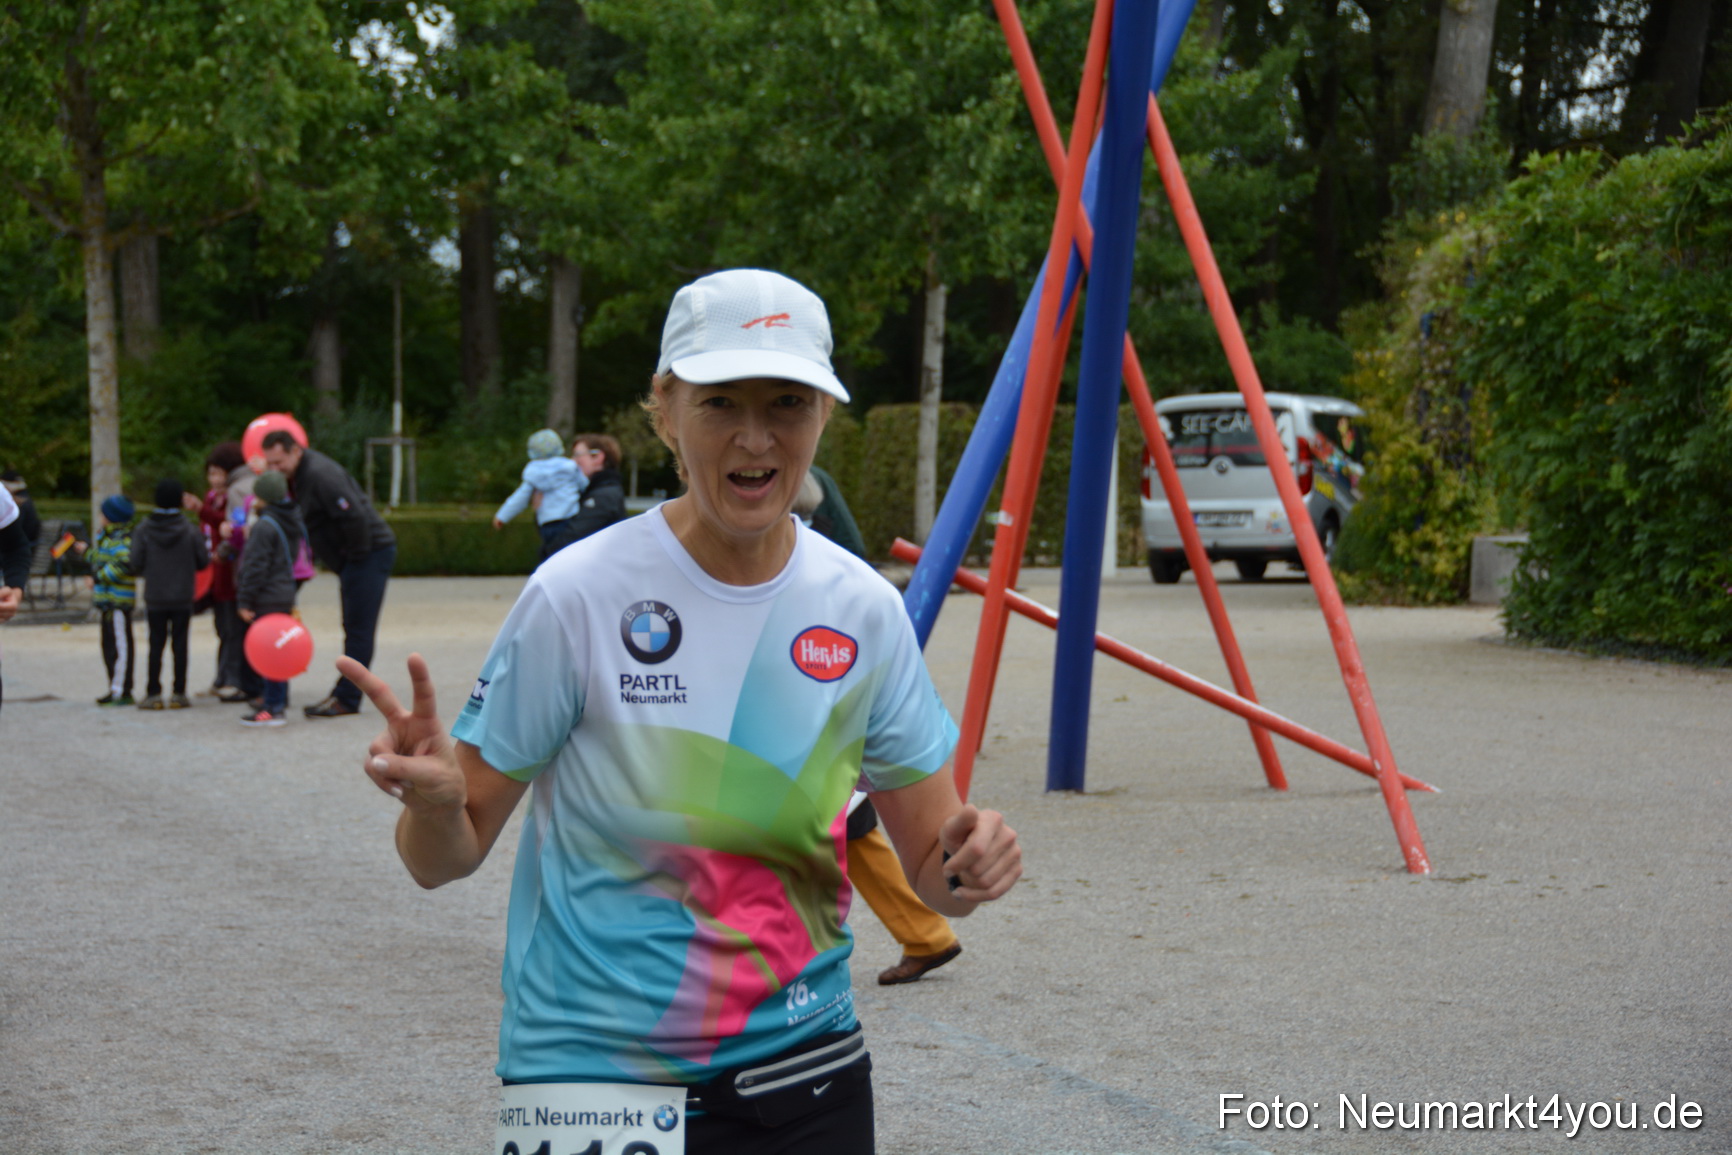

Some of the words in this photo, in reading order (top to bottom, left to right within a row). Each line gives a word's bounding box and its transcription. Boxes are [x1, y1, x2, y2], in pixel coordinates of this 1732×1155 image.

[624, 602, 677, 622] BMW
[801, 639, 852, 669] Hervis
[620, 673, 687, 690] PARTL
[620, 691, 688, 704] Neumarkt
[786, 977, 818, 1010] 16.
[498, 1107, 531, 1127] PARTL
[535, 1106, 644, 1127] Neumarkt
